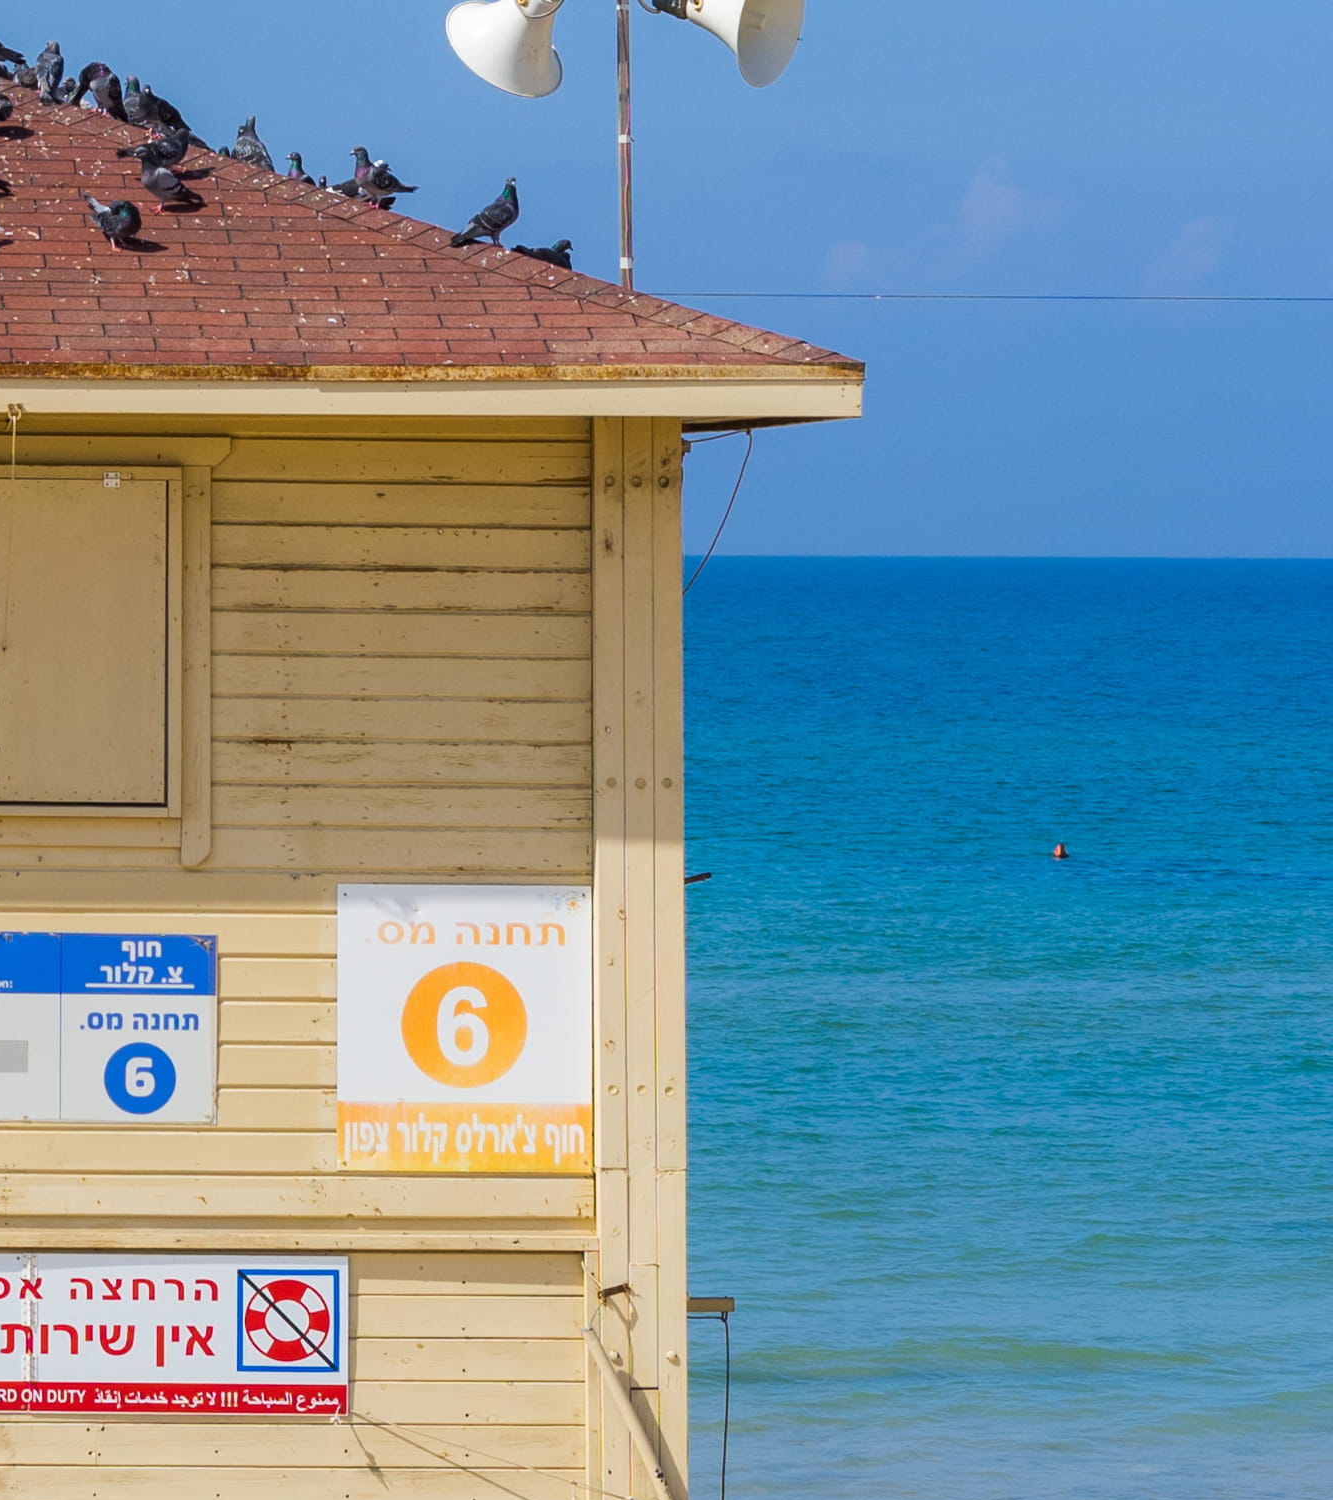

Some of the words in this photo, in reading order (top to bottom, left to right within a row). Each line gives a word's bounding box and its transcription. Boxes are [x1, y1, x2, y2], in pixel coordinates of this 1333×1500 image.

[364, 920, 436, 946] מס.
[455, 921, 566, 947] תחנה
[121, 940, 162, 962] חוף
[100, 962, 154, 985] קלור
[161, 966, 183, 984] צ.
[80, 1012, 123, 1030] מס.
[133, 1012, 199, 1031] תחנה
[436, 984, 491, 1067] 6
[124, 1056, 156, 1098] 6
[344, 1121, 390, 1162] צפון
[396, 1112, 449, 1163] קלור
[544, 1123, 585, 1165] חוף
[70, 1277, 219, 1301] הרחצה
[155, 1324, 215, 1367] אין
[21, 1389, 43, 1404] ON
[46, 1389, 86, 1404] DUTY
[124, 1391, 166, 1406] خدمات
[171, 1393, 204, 1408] توجد
[206, 1391, 217, 1406] لا
[242, 1391, 293, 1407] السباحة
[295, 1395, 339, 1411] ممنوع
